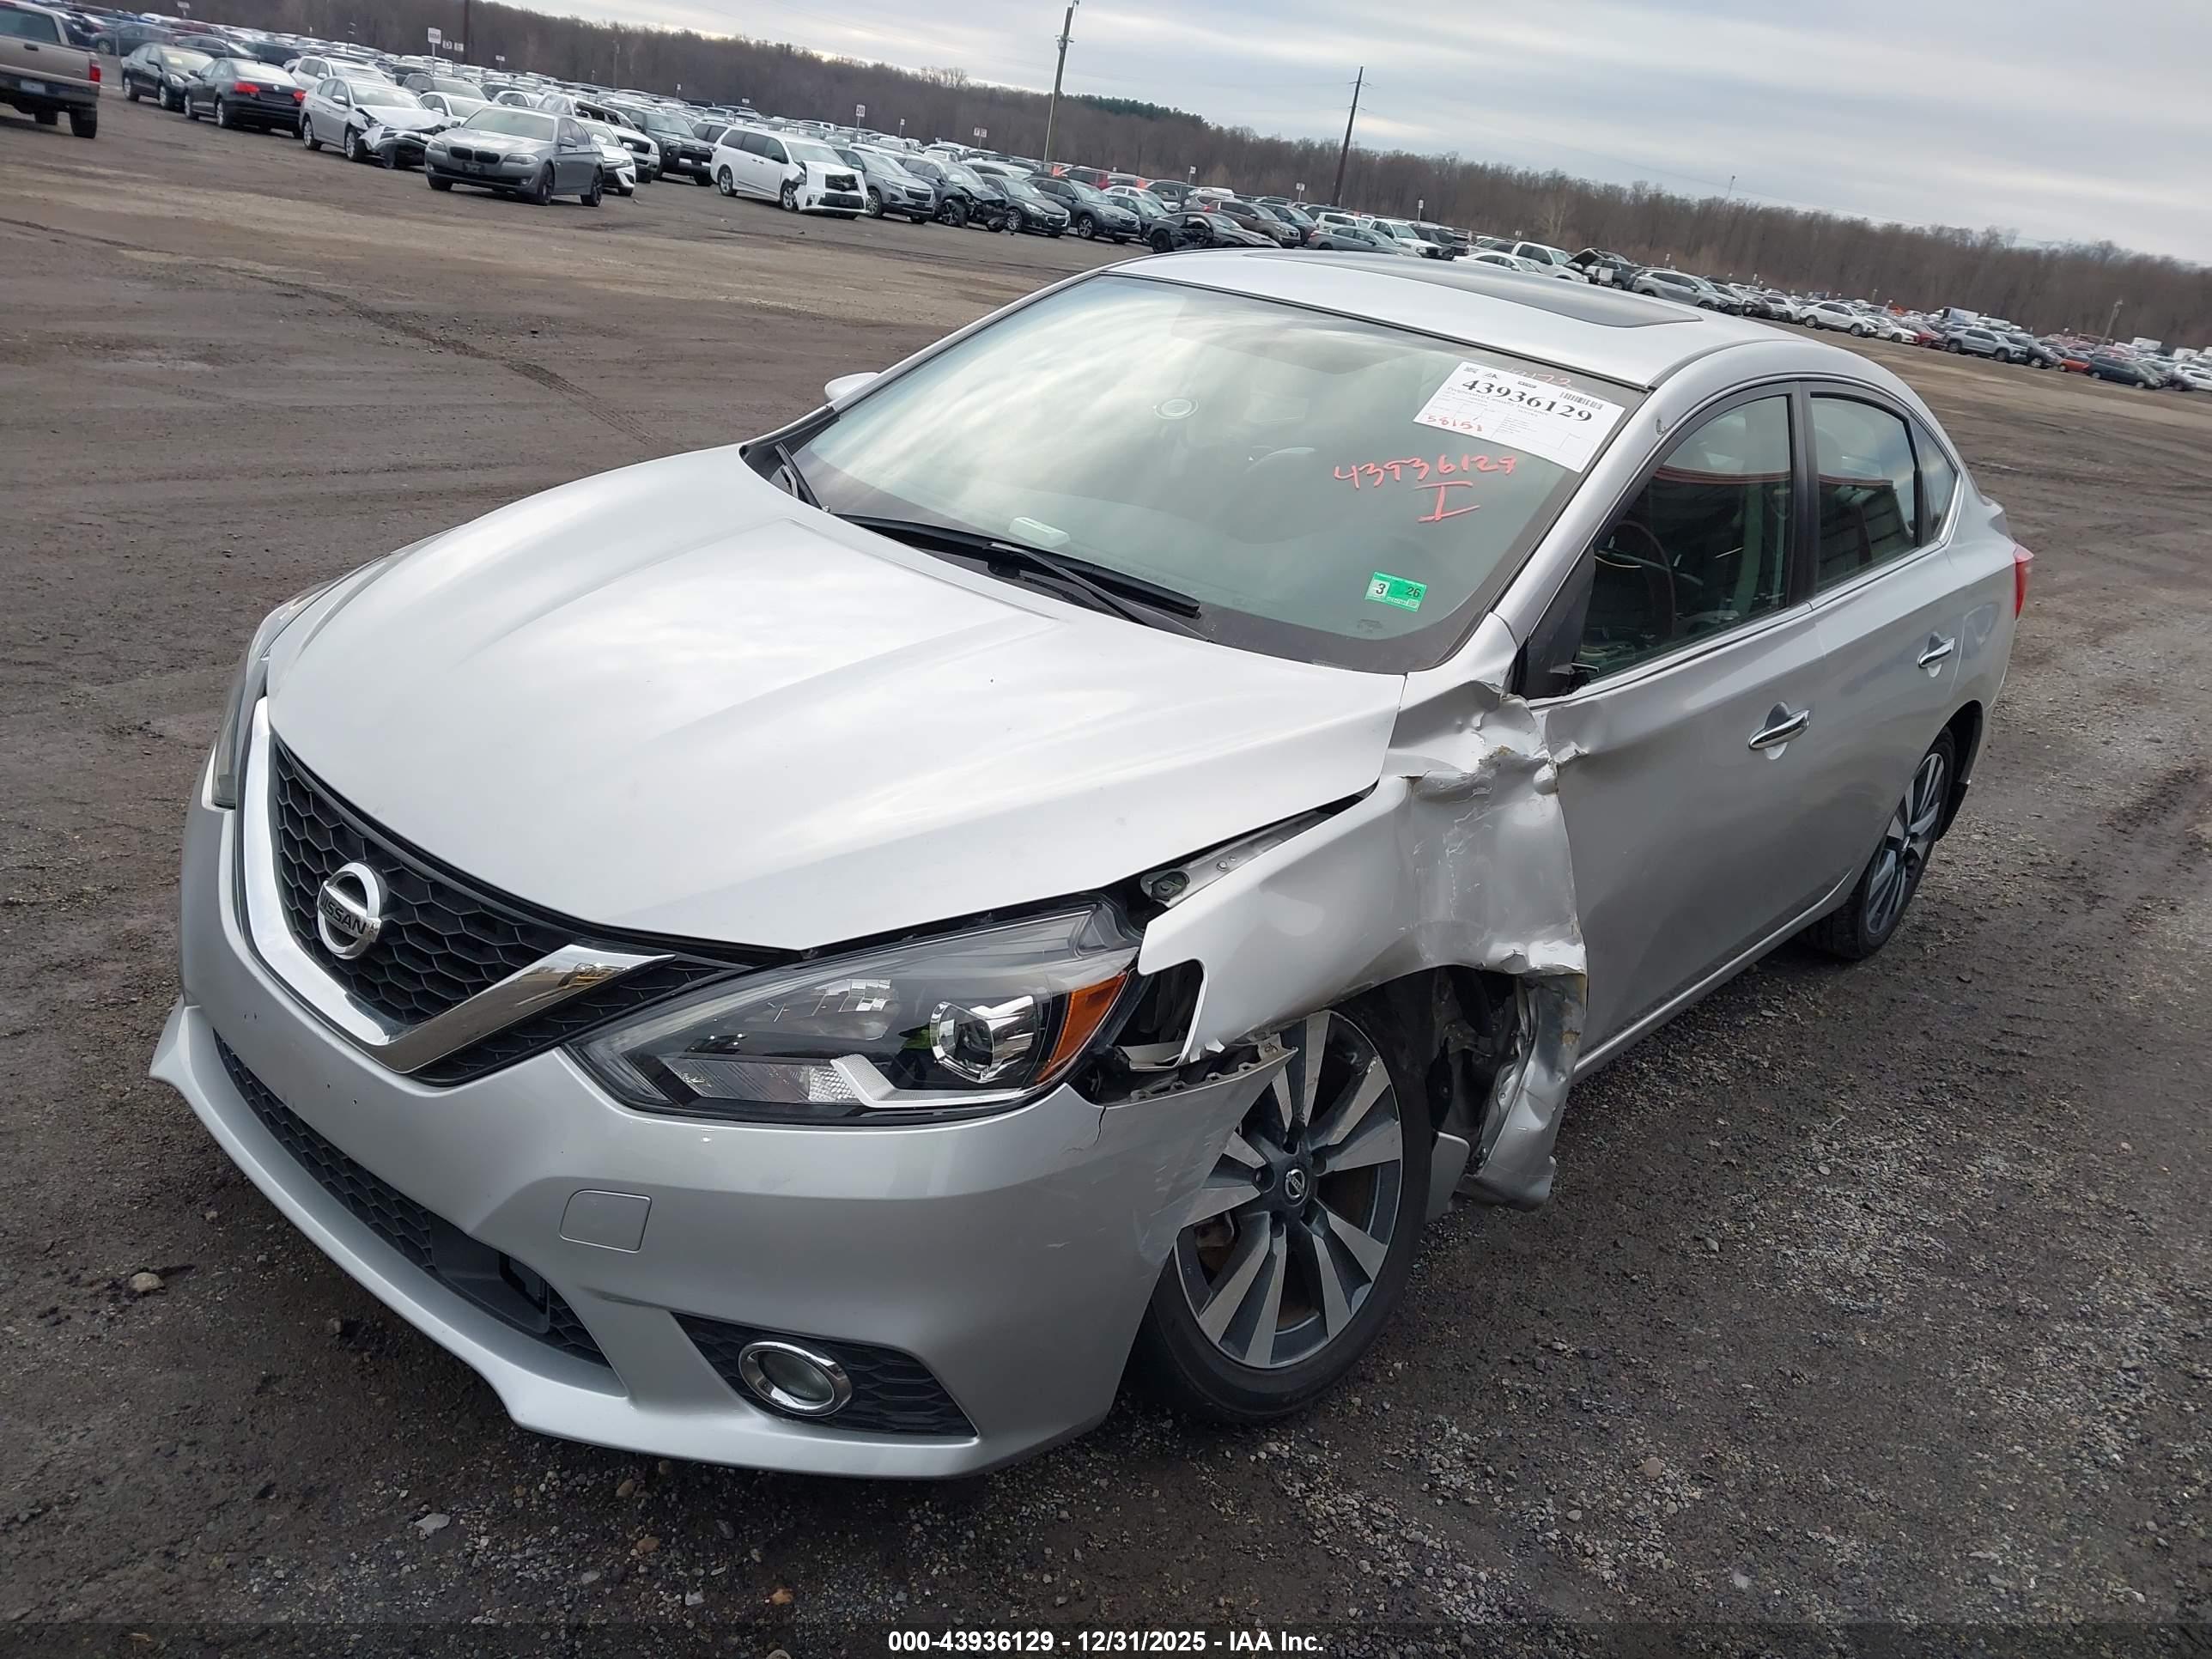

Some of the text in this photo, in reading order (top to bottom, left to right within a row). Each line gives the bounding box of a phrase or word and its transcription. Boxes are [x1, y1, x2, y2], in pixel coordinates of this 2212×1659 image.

[1462, 379, 1593, 422] 43936129
[1376, 583, 1422, 598] 3 26
[319, 895, 368, 935] NISSAN
